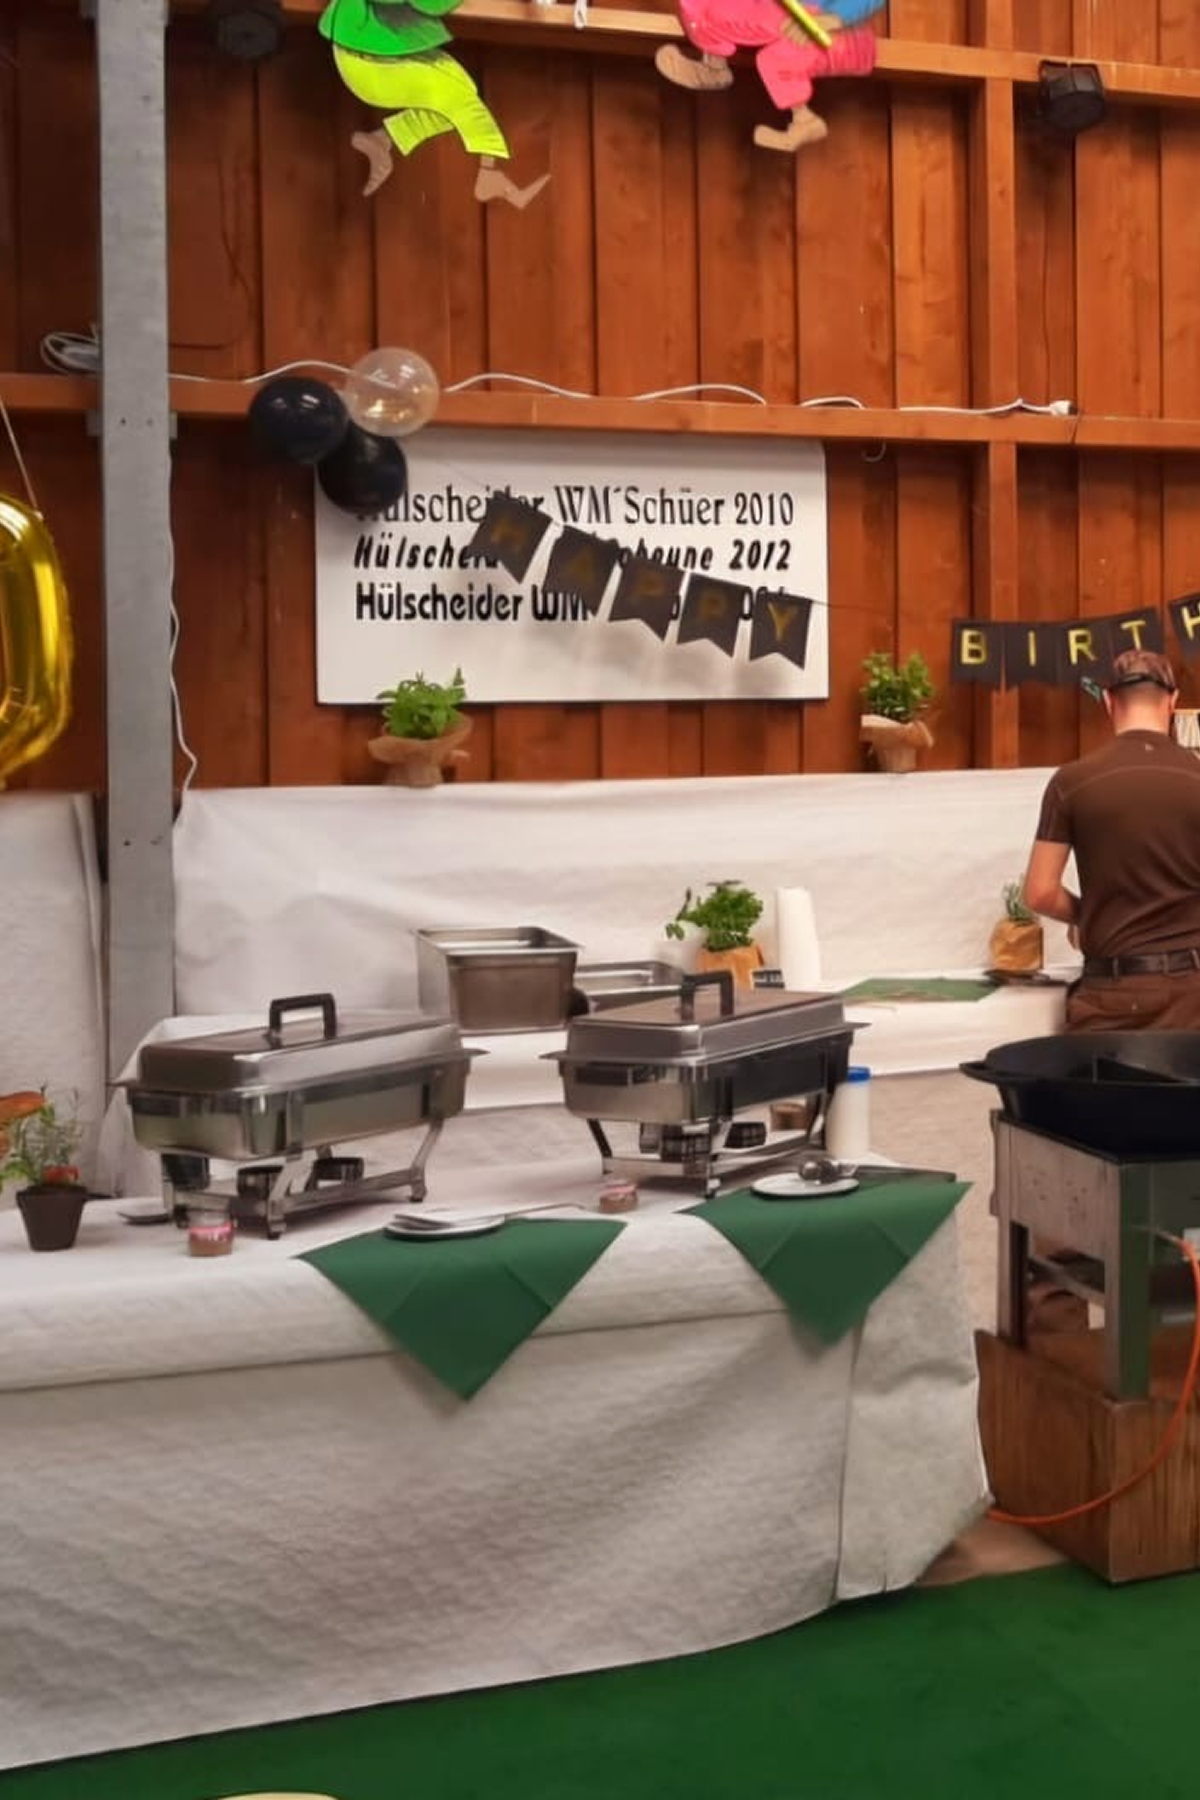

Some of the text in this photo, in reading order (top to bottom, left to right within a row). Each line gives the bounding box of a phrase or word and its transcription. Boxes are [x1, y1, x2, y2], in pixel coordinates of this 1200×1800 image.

[734, 492, 794, 526] 2010
[729, 538, 792, 571] 2012
[356, 581, 524, 622] Hülscheider
